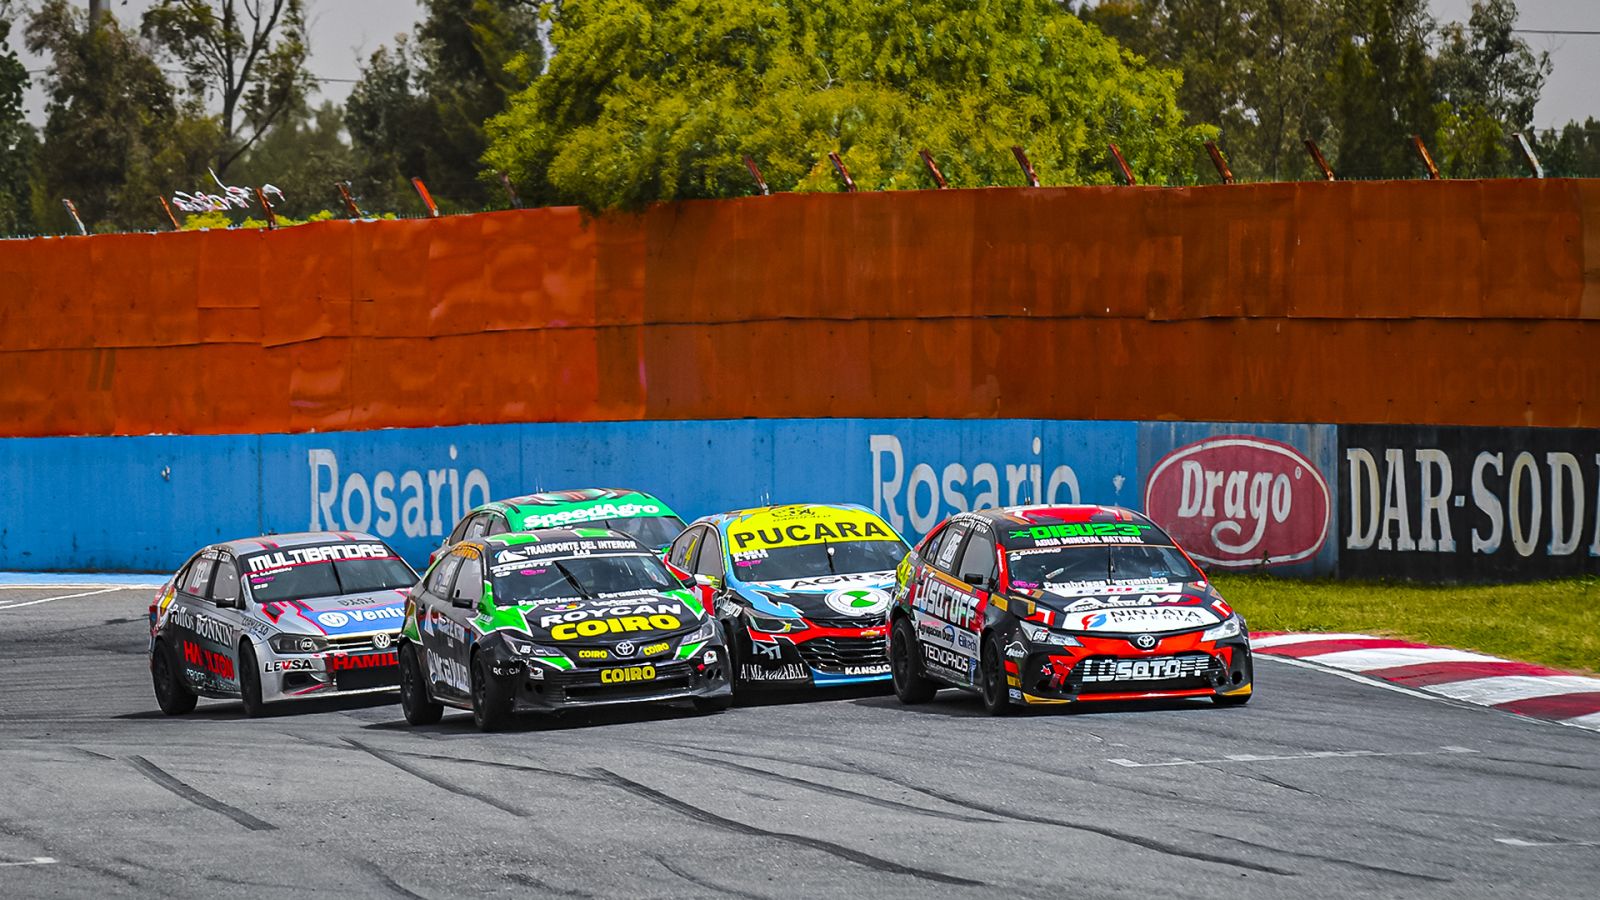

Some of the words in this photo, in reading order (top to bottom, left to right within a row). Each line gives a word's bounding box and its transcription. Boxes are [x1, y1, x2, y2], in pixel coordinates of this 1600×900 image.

[309, 444, 491, 538] Rosario
[870, 435, 1080, 534] Rosario
[523, 503, 660, 528] SpeedAgro
[1178, 460, 1292, 554] Drago
[734, 521, 889, 548] PUCARA
[1029, 523, 1142, 539] DIBU23
[1034, 538, 1061, 547] AGUA
[1061, 536, 1102, 545] MINERAL
[1102, 536, 1144, 544] NATURAL
[248, 544, 388, 572] MULTIBANDAS
[524, 542, 580, 556] TRANSPORTE
[580, 541, 597, 550] DEL
[598, 540, 637, 550] INTERIOR
[541, 604, 682, 628] ROYCAN
[550, 614, 681, 641] COIRO
[579, 650, 608, 659] COIRO
[643, 642, 669, 656] COIRO
[264, 659, 313, 672] LEVSA
[601, 665, 656, 684] COIRO
